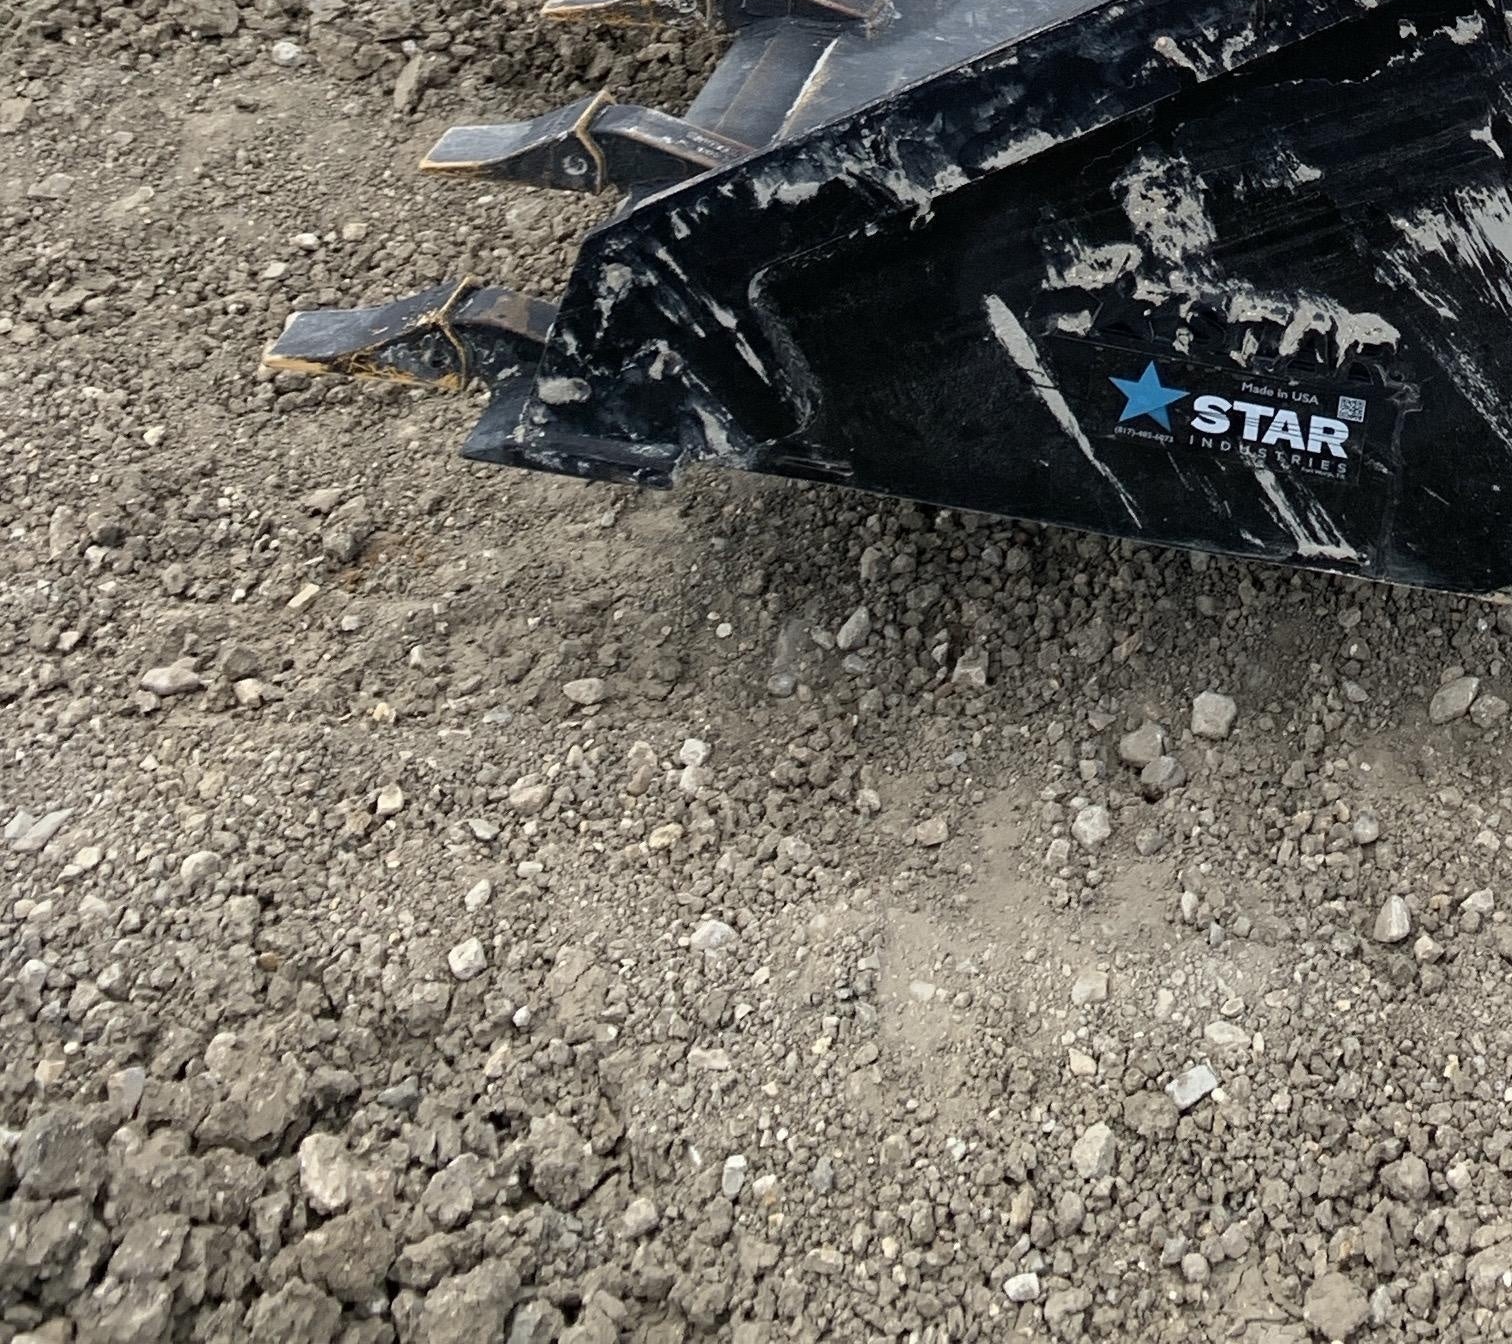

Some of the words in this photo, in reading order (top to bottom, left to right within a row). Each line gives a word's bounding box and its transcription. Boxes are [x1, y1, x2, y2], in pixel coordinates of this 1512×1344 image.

[1241, 381, 1274, 399] Made
[1276, 387, 1289, 400] in
[1291, 390, 1319, 406] USA
[1190, 395, 1349, 459] STAR
[1189, 434, 1348, 474] INDUSTRIES
